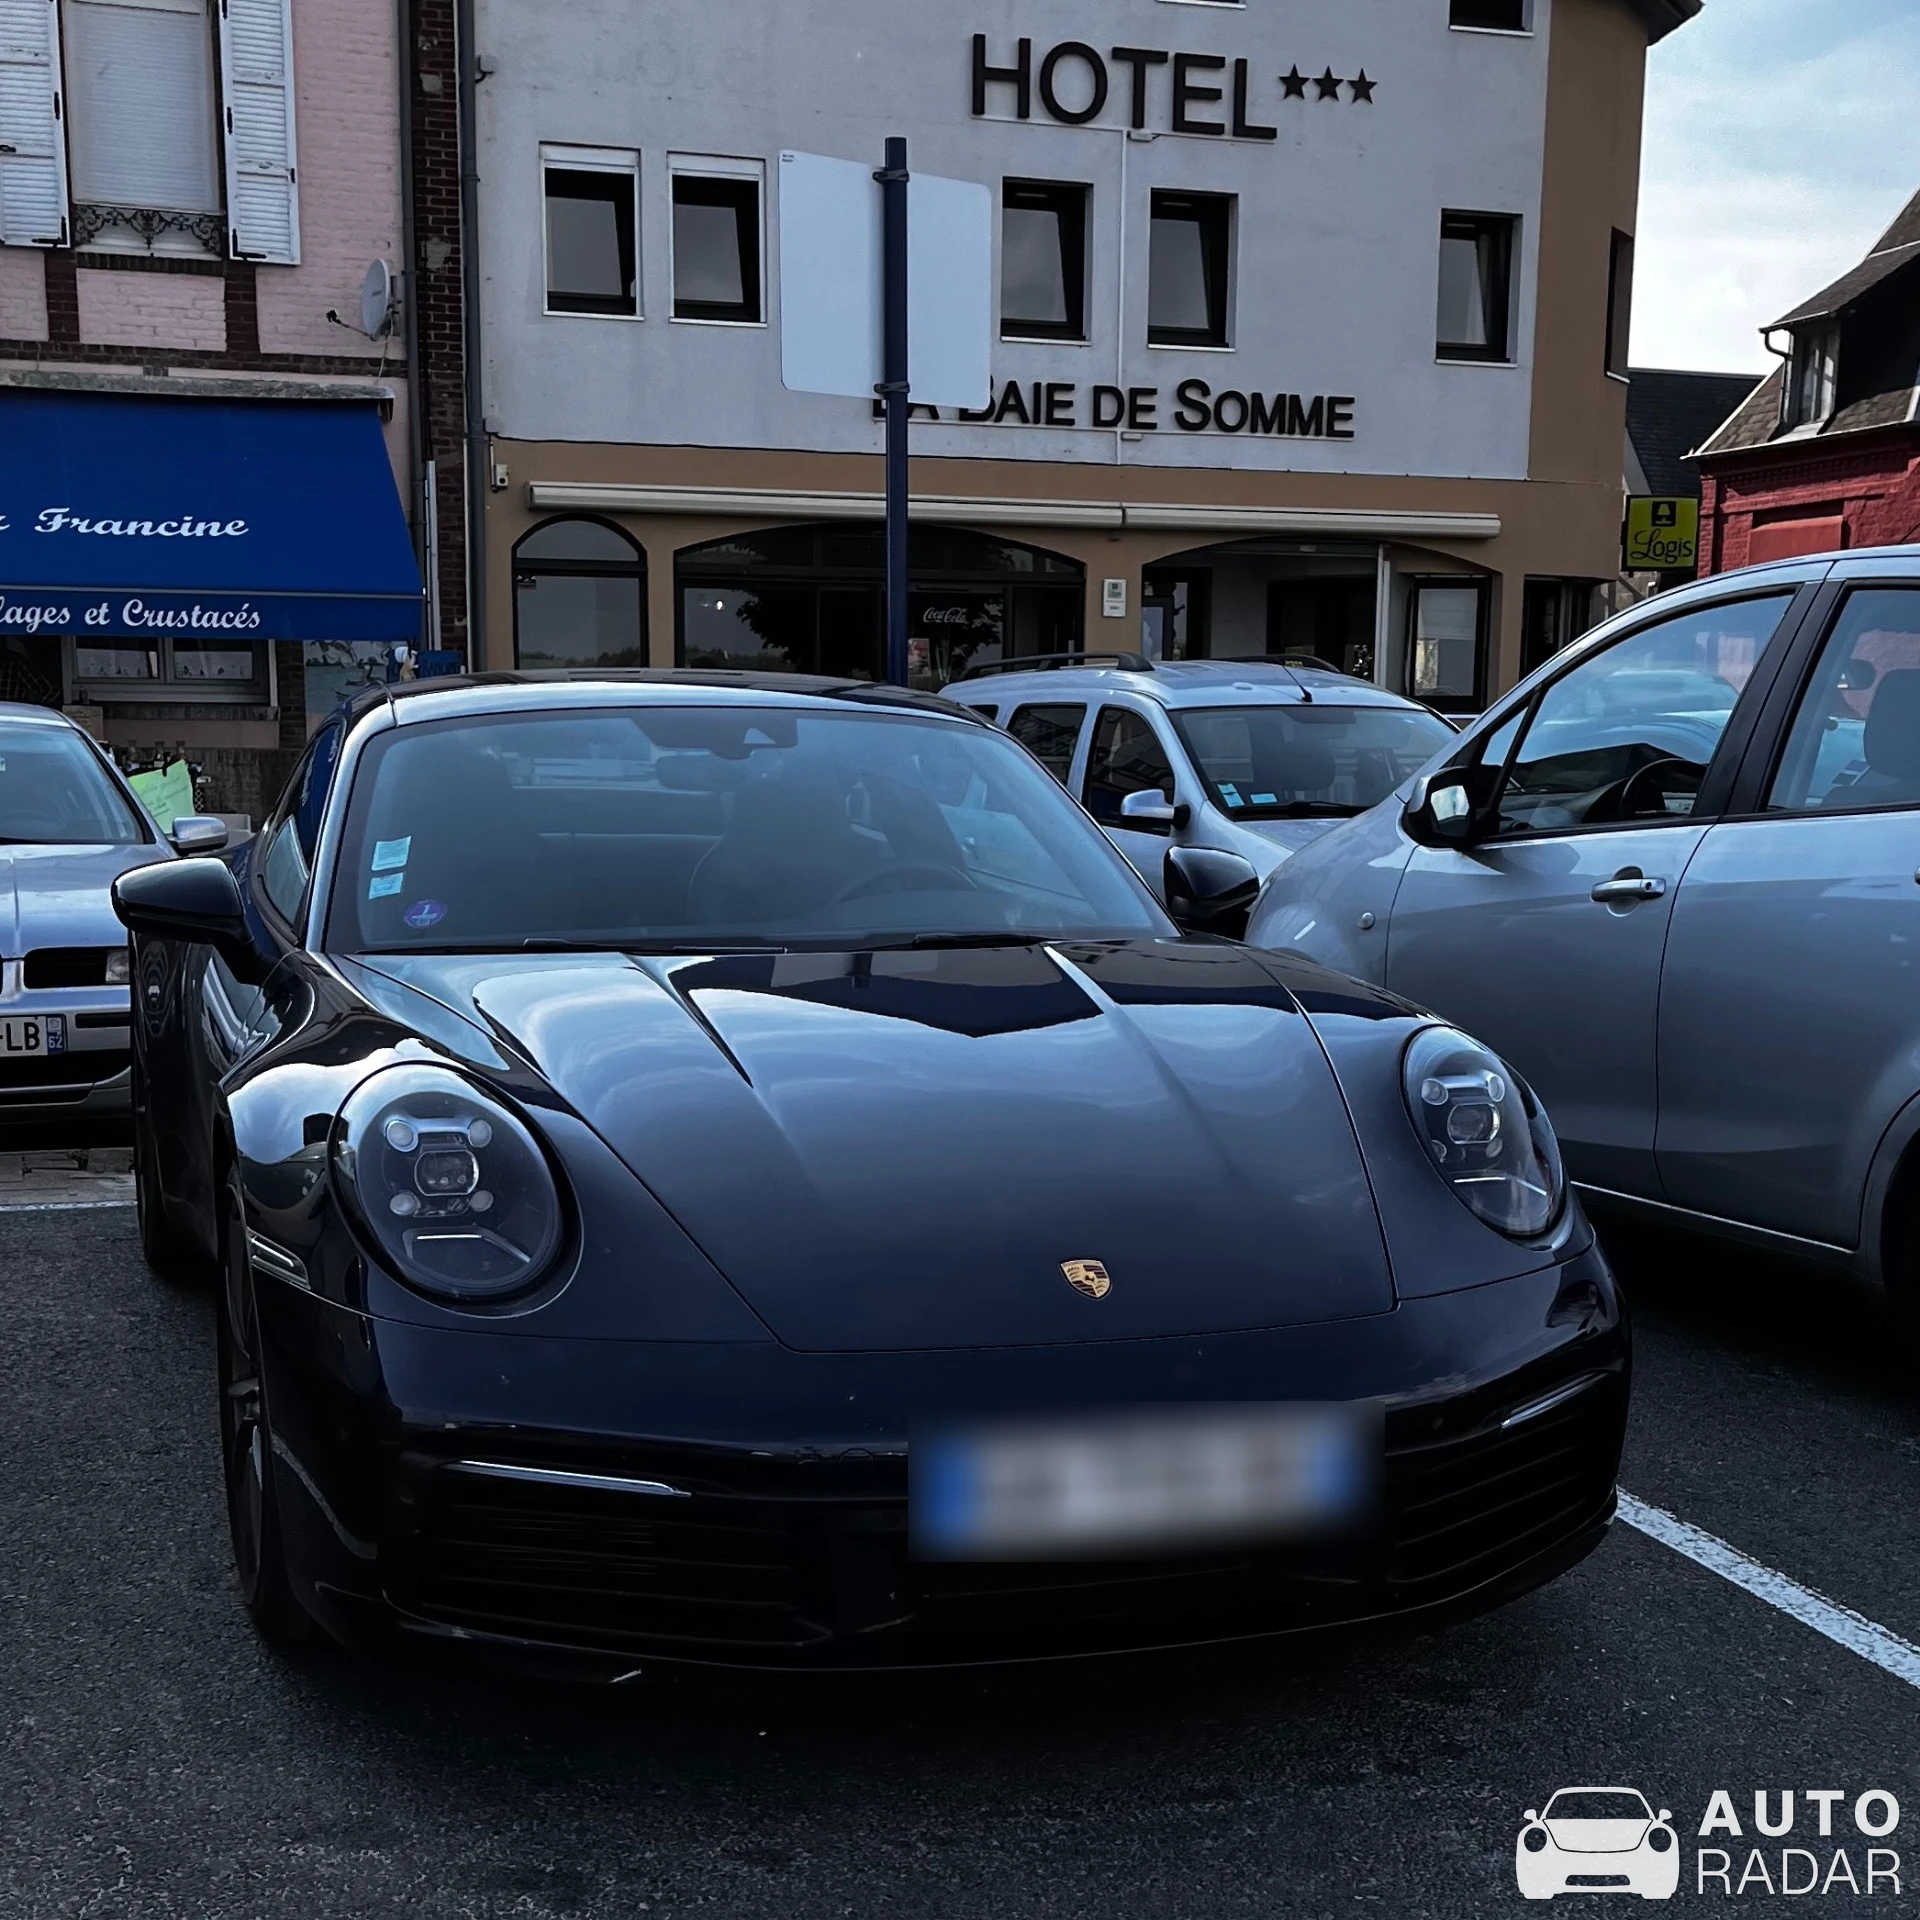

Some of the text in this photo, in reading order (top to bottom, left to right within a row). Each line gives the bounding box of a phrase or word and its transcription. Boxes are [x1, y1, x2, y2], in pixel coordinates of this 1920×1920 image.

[972, 33, 1277, 139] HOTEL
[1093, 385, 1158, 430] DE
[34, 507, 249, 537] Francine
[1629, 528, 1693, 564] Logis
[84, 602, 110, 626] et
[122, 598, 261, 629] Crustacés
